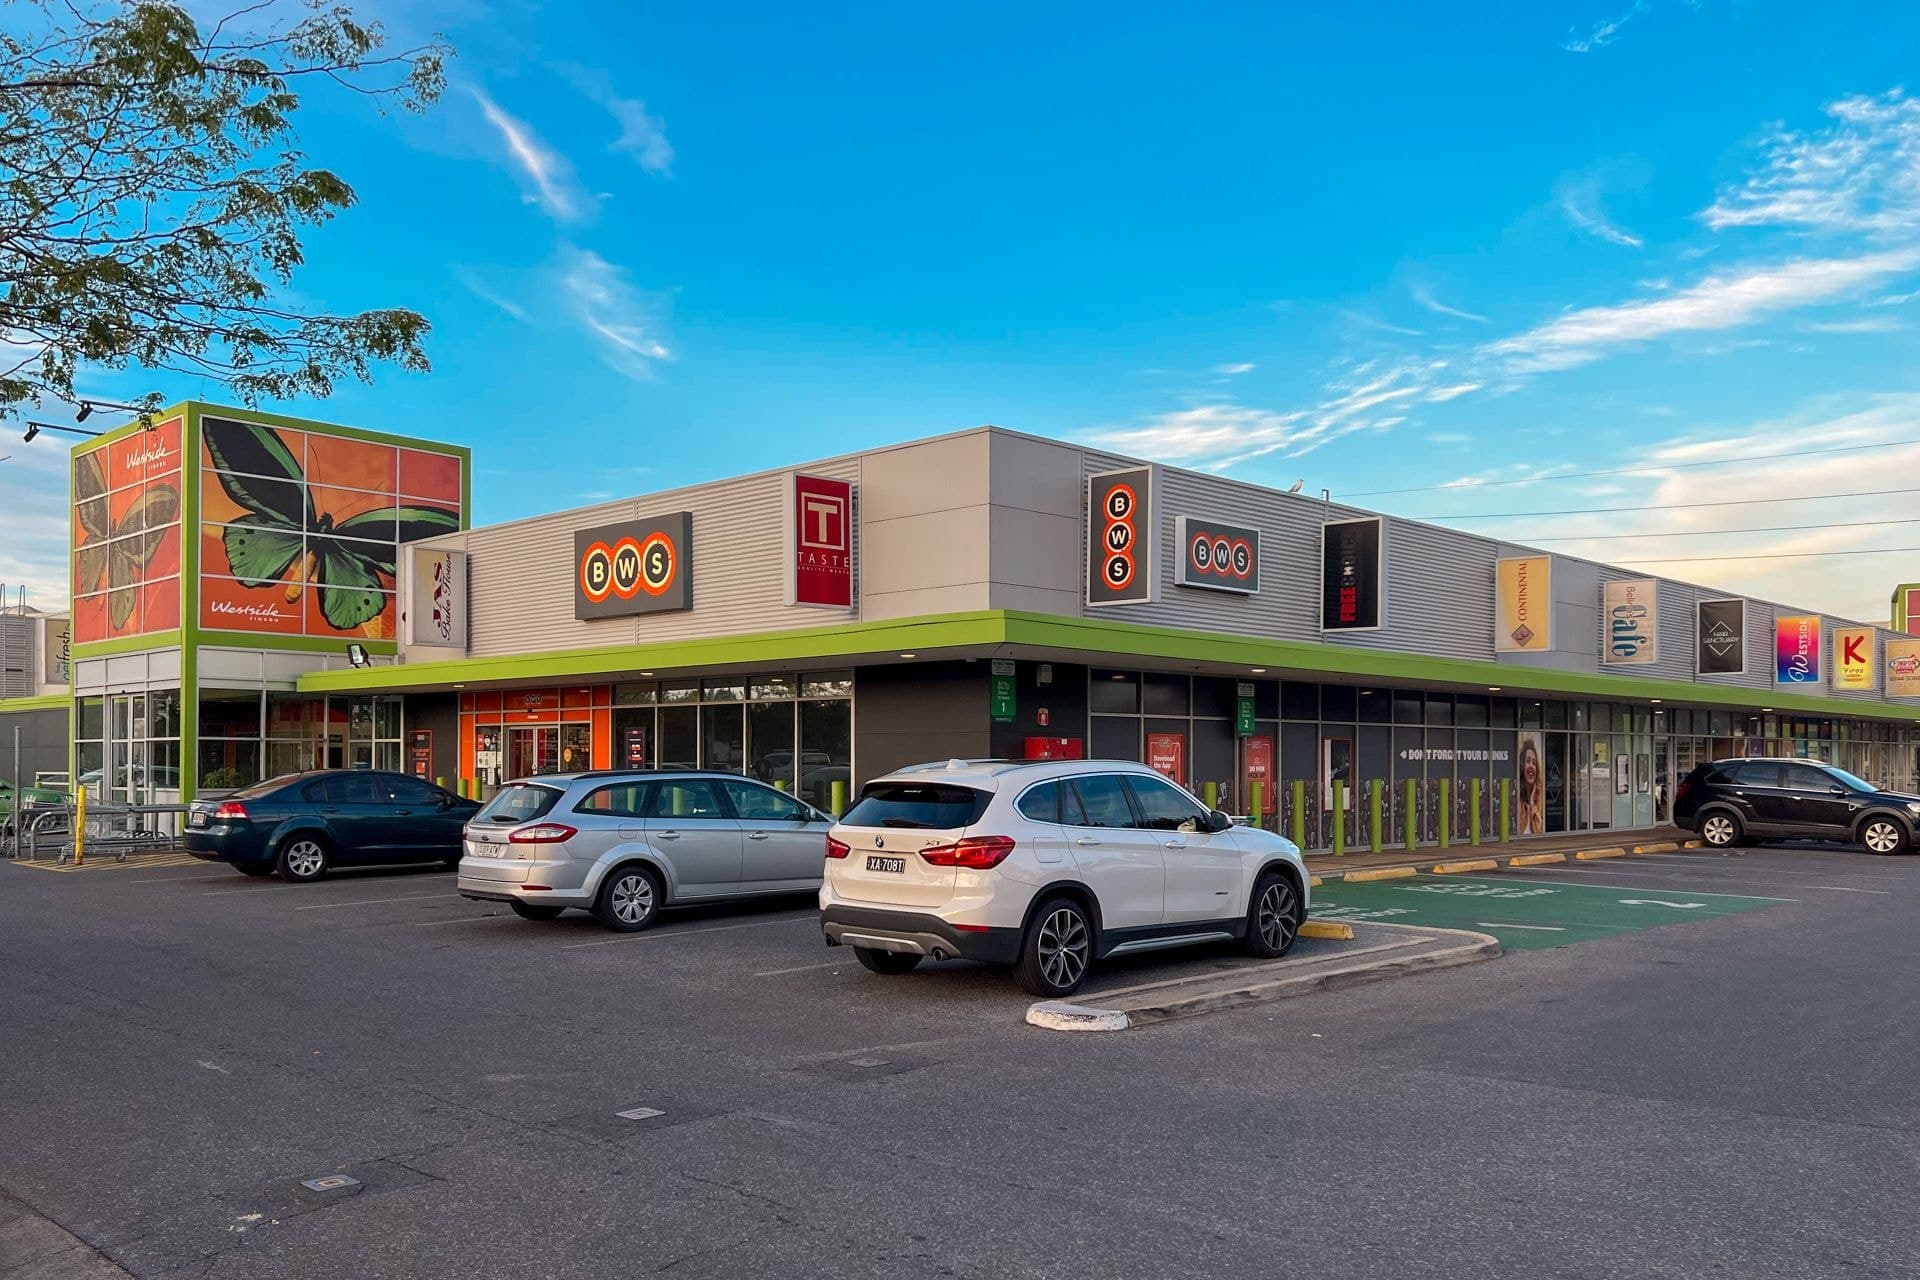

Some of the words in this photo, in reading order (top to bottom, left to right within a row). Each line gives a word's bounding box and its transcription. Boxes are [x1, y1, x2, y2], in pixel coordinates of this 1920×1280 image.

[127, 436, 181, 470] Westside
[593, 552, 664, 583] BWS
[797, 551, 849, 568] TASTE
[1199, 545, 1245, 567] BWS
[1518, 561, 1528, 622] CONTINENTAL
[211, 601, 302, 618] Westside
[1844, 635, 1866, 666] K
[1462, 751, 1482, 760] YOUR
